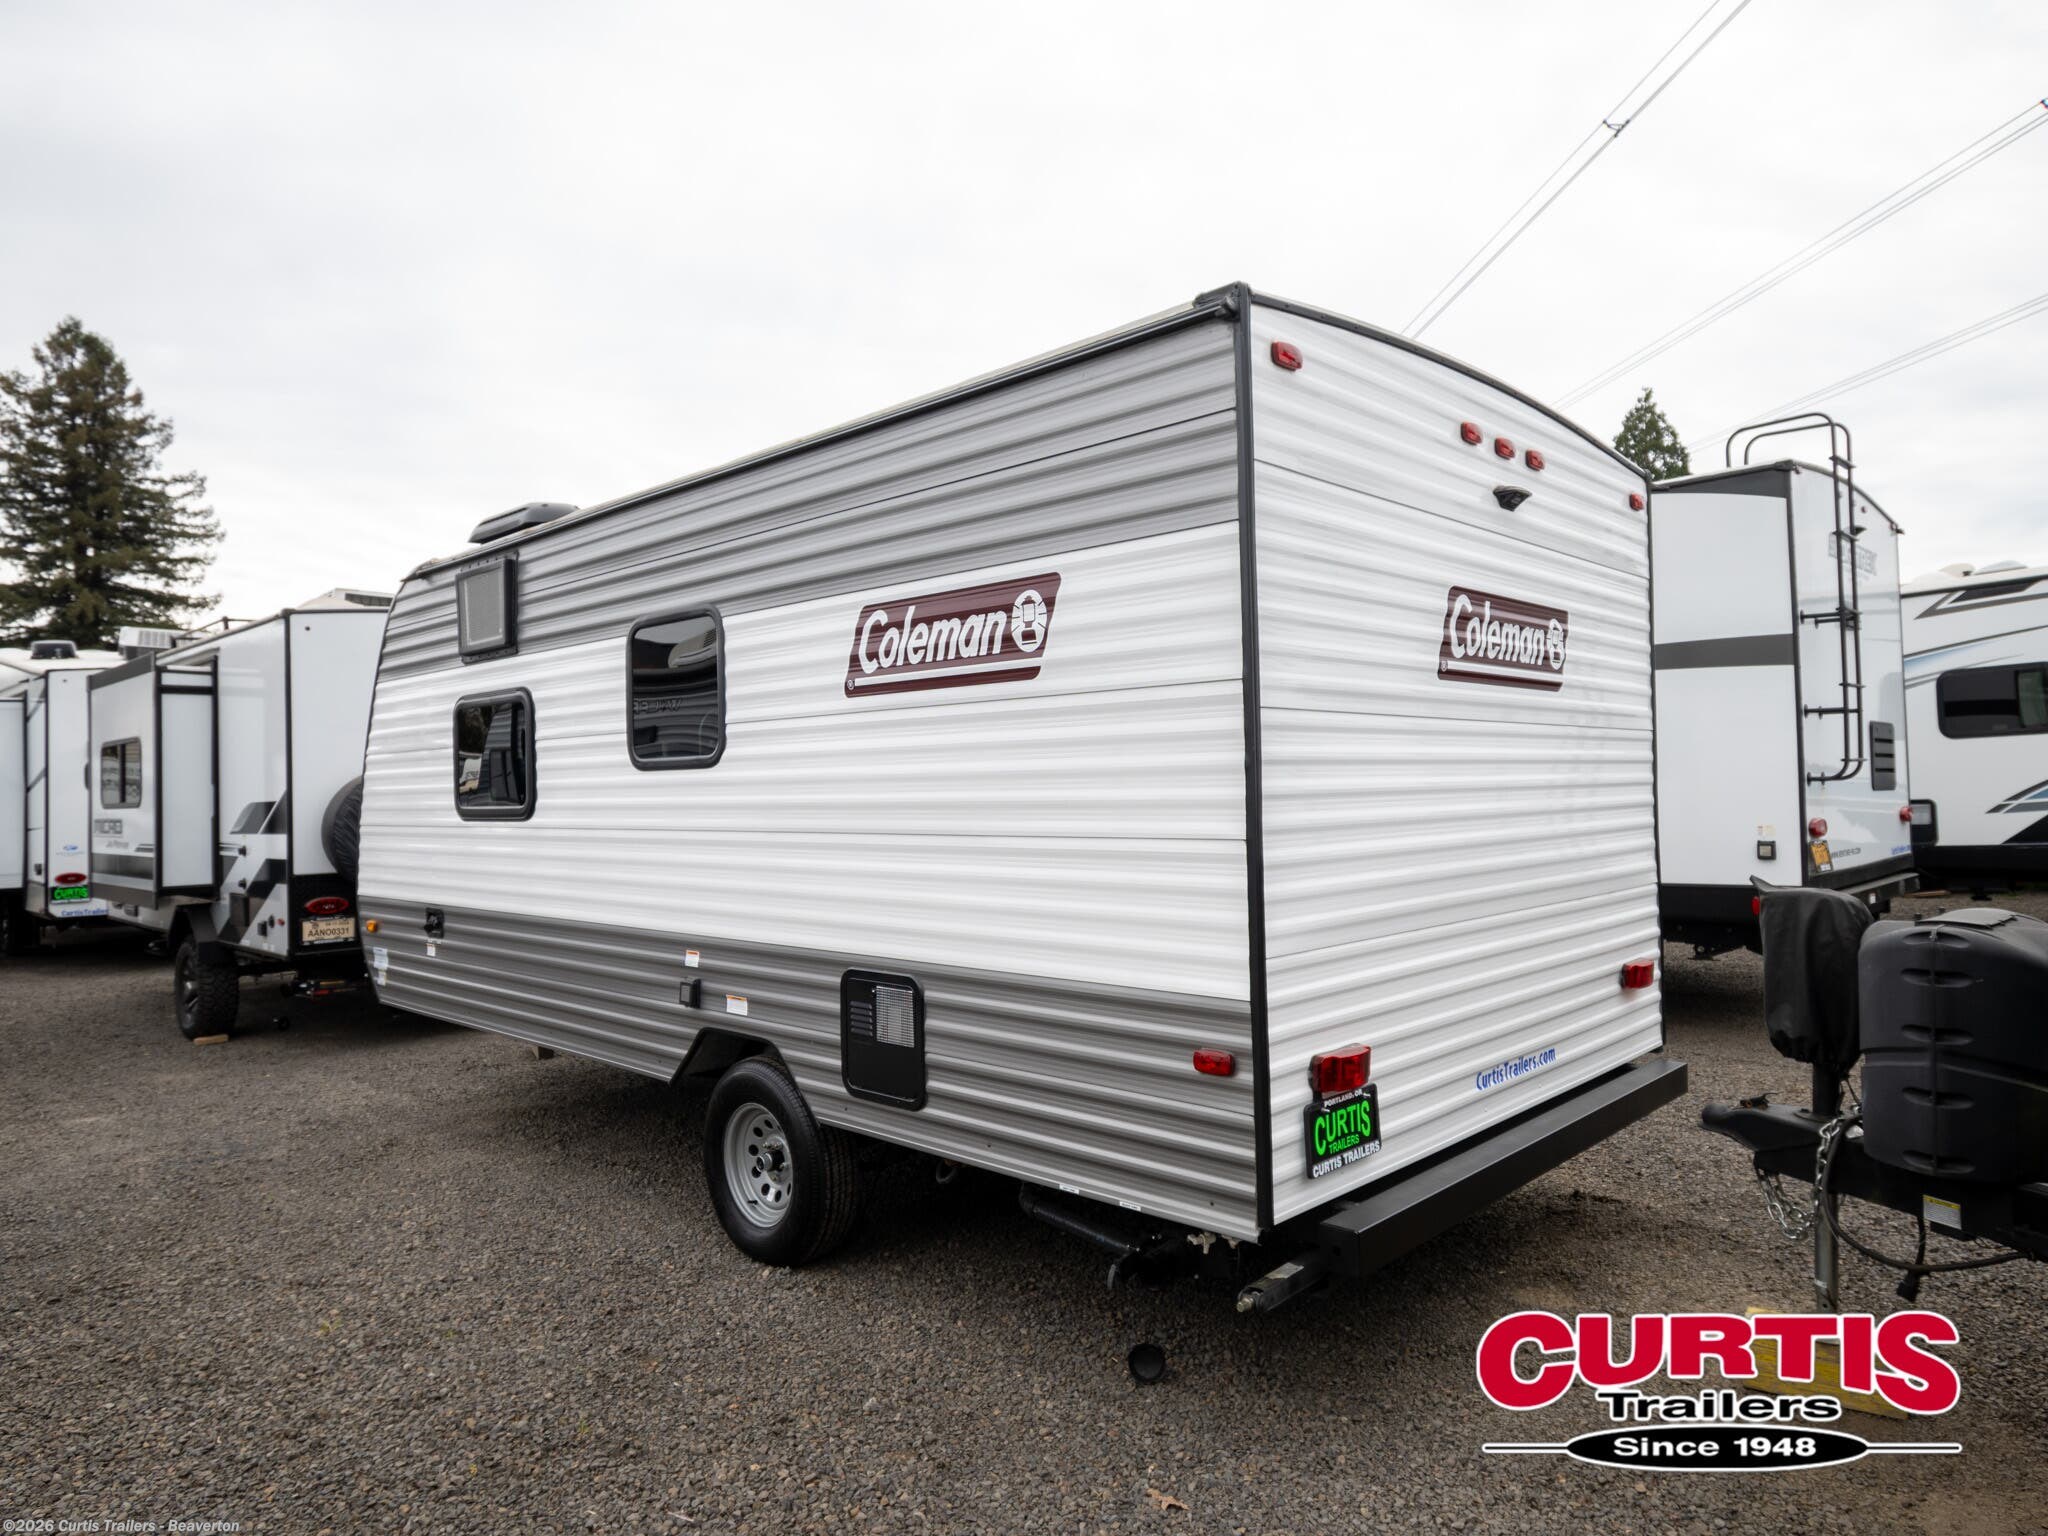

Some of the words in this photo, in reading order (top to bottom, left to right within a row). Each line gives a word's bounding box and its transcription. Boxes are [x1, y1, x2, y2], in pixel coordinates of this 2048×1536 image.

[858, 605, 1008, 674] Coleman
[1450, 594, 1546, 666] Coleman
[1476, 1048, 1557, 1091] CurtisTrailers.com
[1314, 1100, 1371, 1156] CURTIS
[1328, 1134, 1360, 1154] TRAILERS
[1312, 1156, 1342, 1178] CURTIS
[1343, 1140, 1380, 1165] TRAILERS
